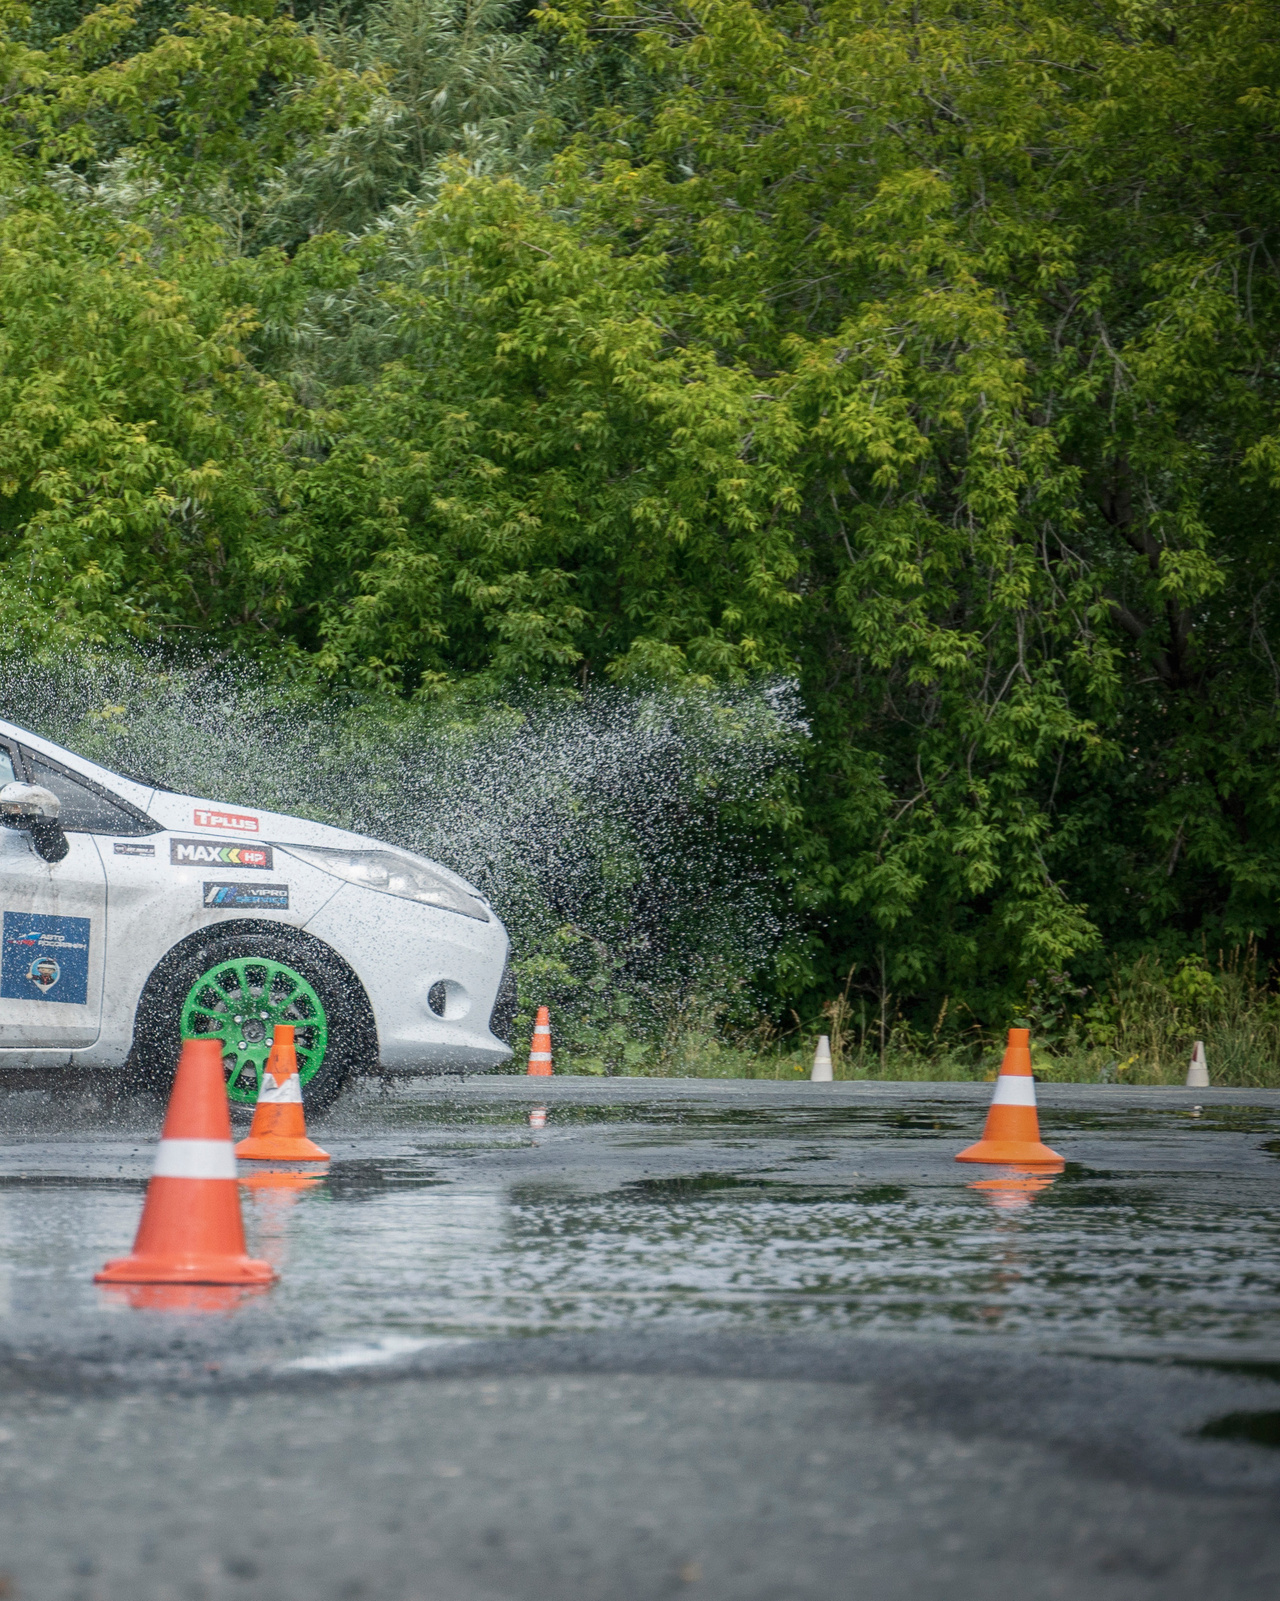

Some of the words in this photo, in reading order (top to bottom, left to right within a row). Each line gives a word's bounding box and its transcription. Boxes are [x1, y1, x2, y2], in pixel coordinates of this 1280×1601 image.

[177, 844, 223, 862] MAX
[244, 852, 264, 863] HP
[249, 889, 288, 897] VIPRO
[235, 896, 288, 904] SERVICE
